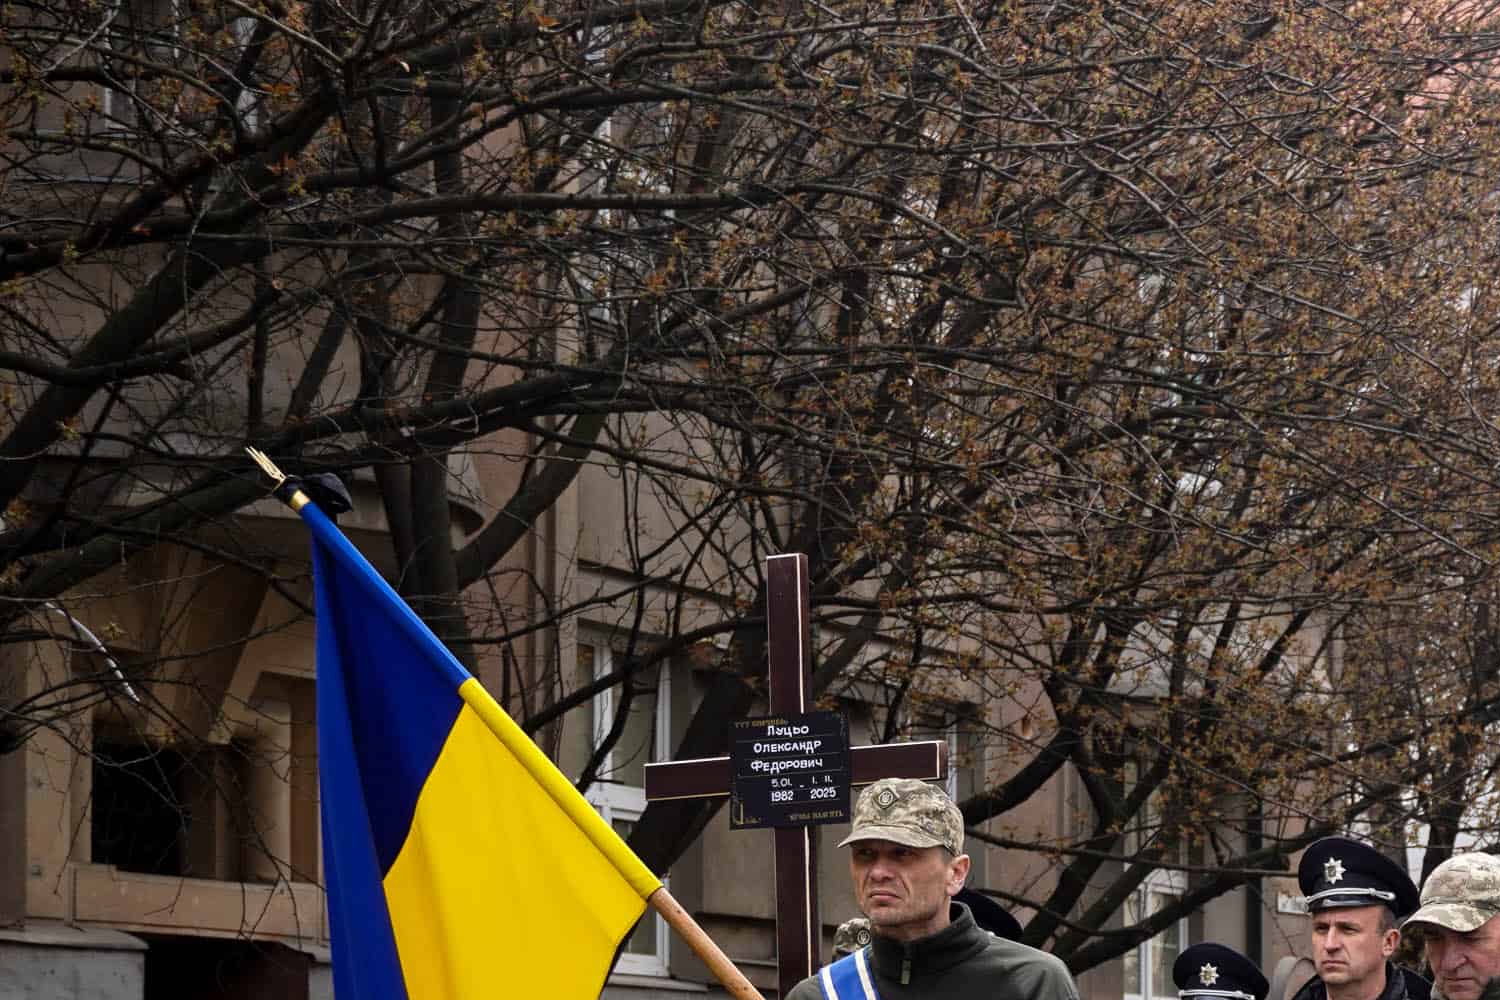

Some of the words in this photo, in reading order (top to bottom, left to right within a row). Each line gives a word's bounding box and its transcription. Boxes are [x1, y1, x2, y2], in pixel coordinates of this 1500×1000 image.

[753, 740, 822, 754] ОЛЕКСАНДР
[751, 758, 823, 774] ФЕДОРОВИЧ
[771, 790, 794, 802] 1982
[810, 786, 837, 799] 2025
